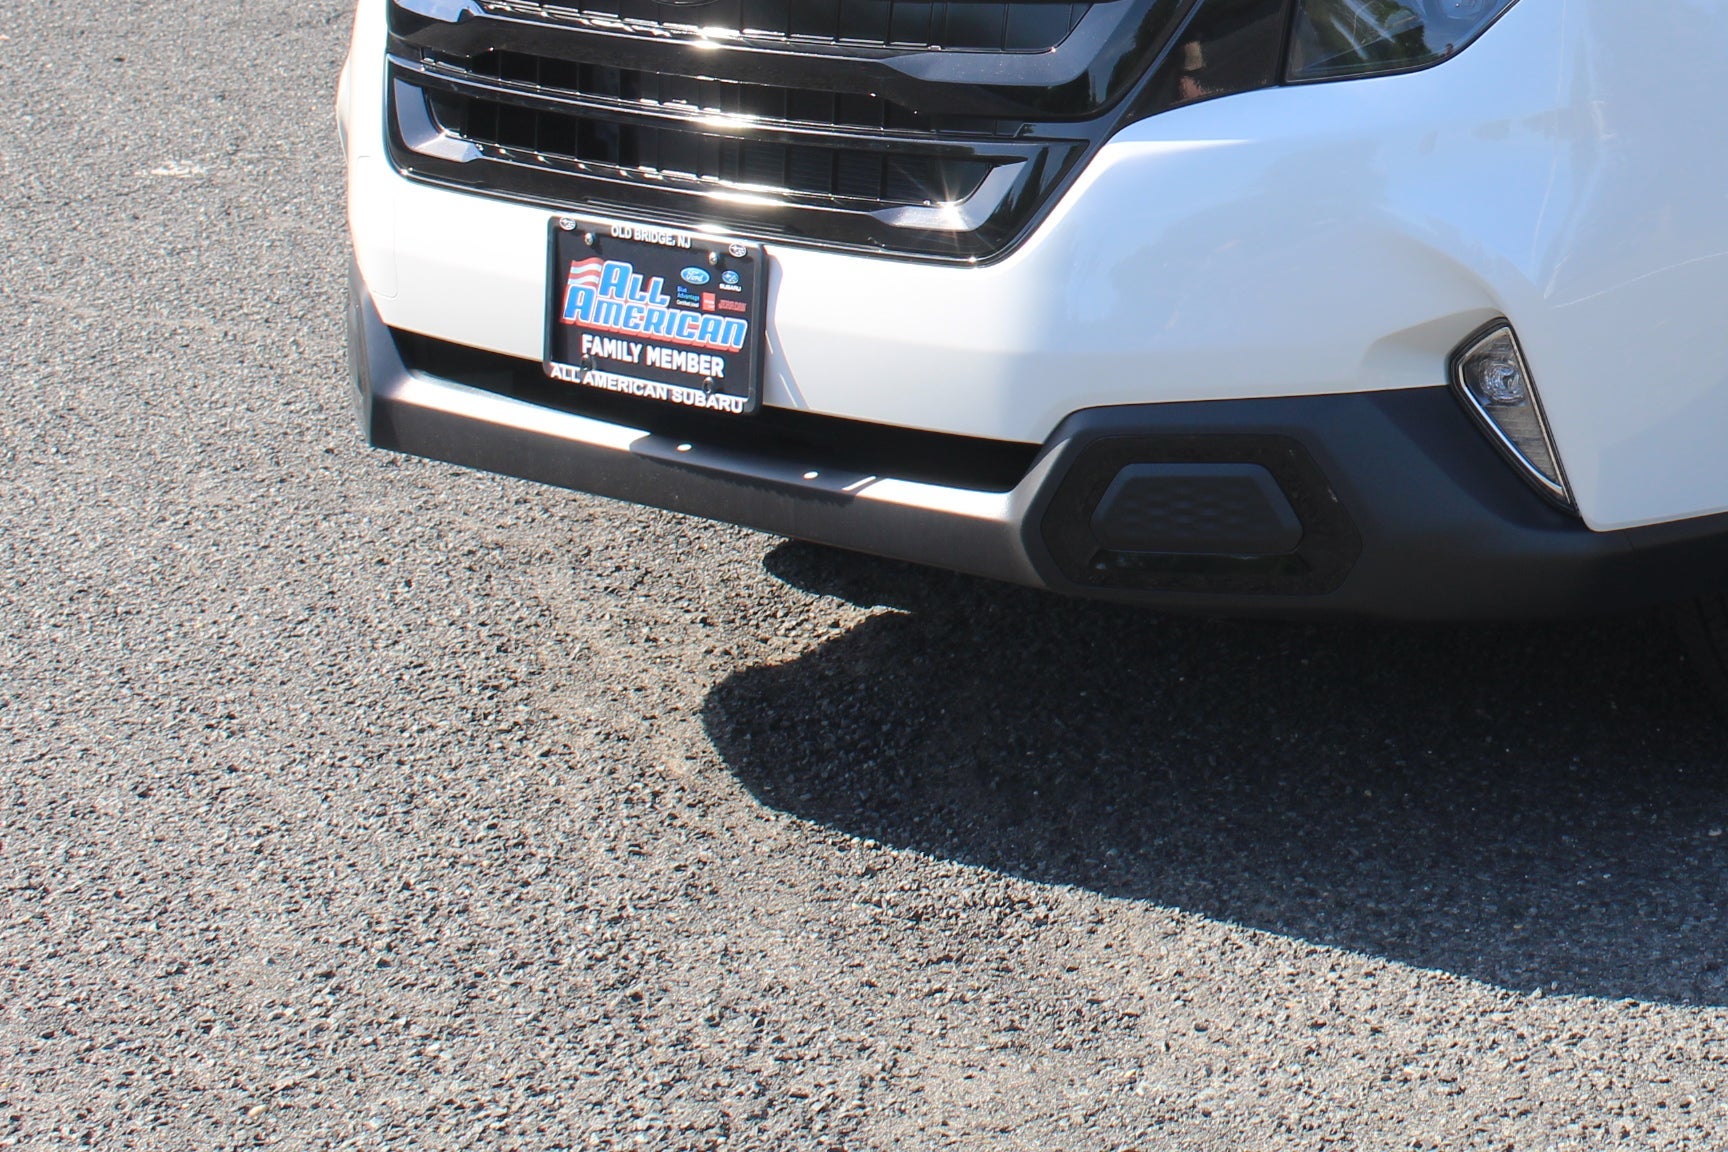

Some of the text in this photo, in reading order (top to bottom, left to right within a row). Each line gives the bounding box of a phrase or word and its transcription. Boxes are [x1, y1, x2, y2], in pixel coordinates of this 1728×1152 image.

[610, 224, 632, 239] OLD
[677, 234, 692, 249] NJ
[597, 260, 671, 308] ALL
[562, 284, 749, 352] AMERICAN
[581, 334, 725, 379] FAMILY MEMBER
[549, 363, 746, 414] ALL AMERICAN SUBARU
